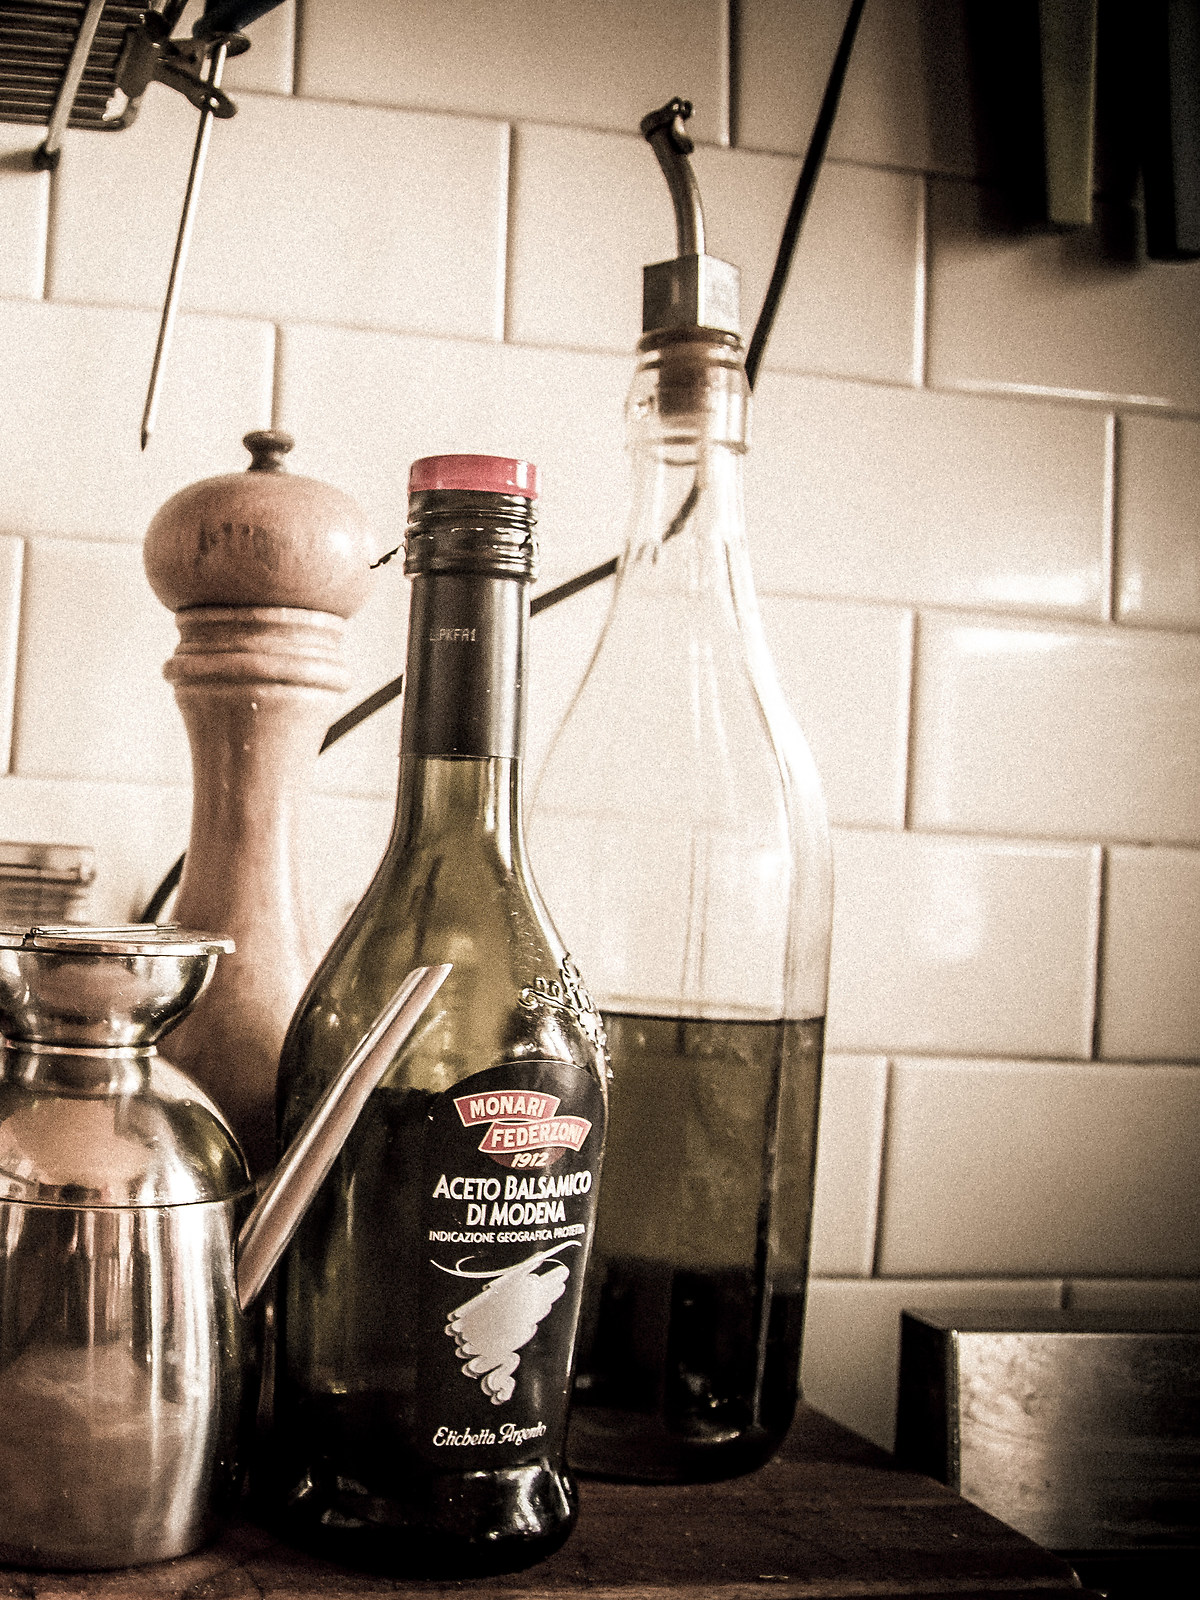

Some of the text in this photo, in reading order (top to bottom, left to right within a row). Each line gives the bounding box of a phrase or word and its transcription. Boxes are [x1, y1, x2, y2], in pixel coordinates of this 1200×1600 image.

[469, 1095, 547, 1119] MONARI
[490, 1122, 584, 1148] FEDERZONI
[510, 1151, 550, 1168] 1912
[432, 1170, 593, 1201] ACETO BALSAMICO
[465, 1200, 567, 1226] DI MODENA
[428, 1230, 496, 1243] INDICAZIONE
[496, 1229, 553, 1243] GEOGRAFICA
